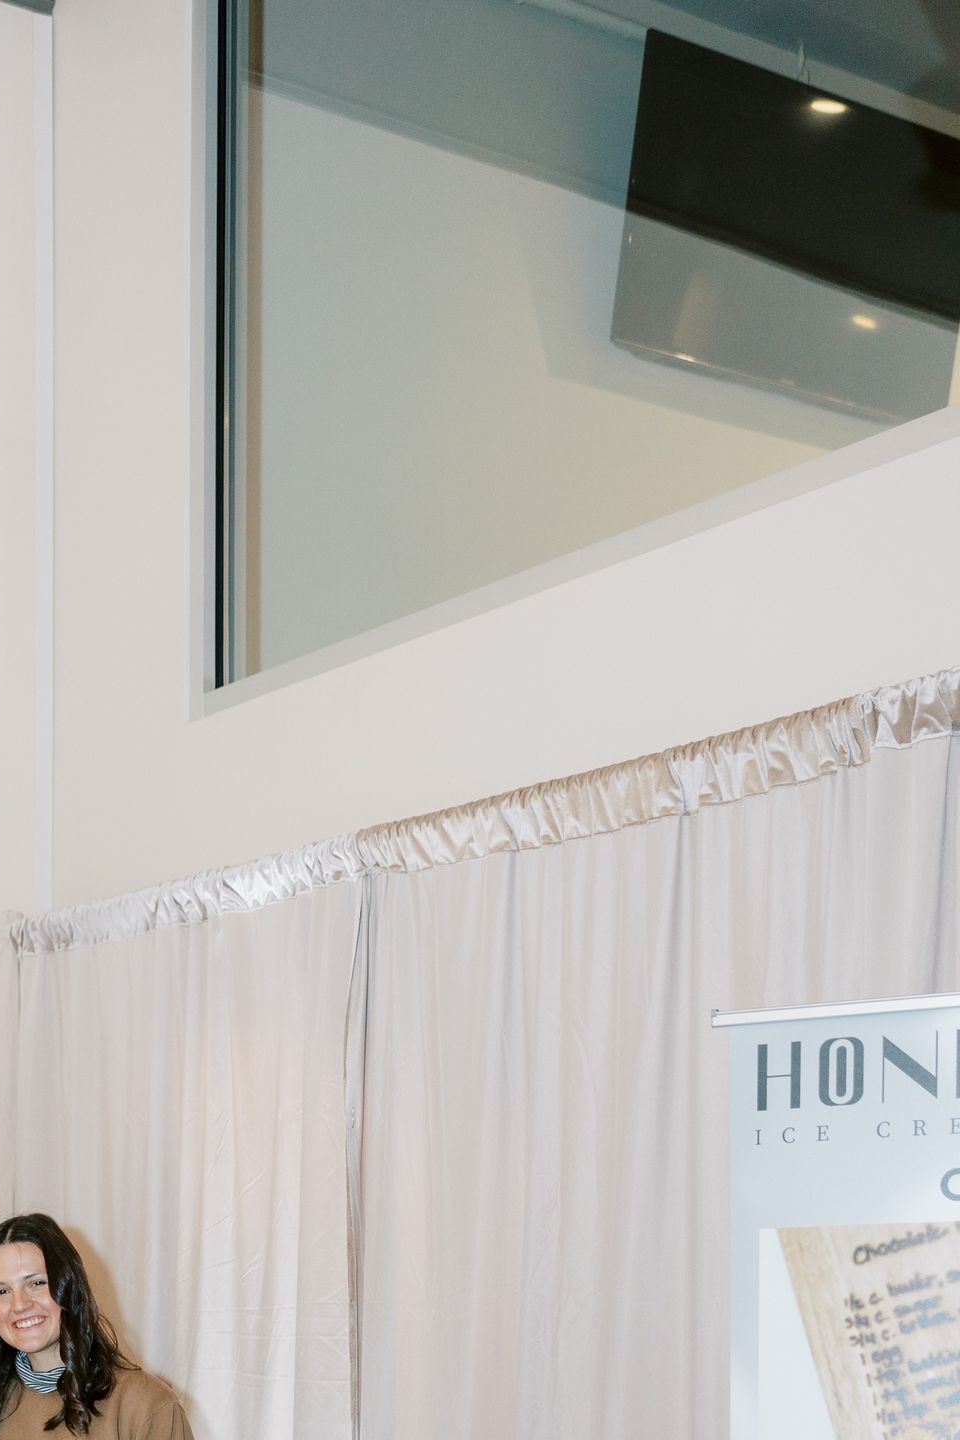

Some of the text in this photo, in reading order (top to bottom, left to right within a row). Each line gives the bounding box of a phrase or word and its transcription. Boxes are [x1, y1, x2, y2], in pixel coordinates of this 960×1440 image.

[757, 1029, 960, 1111] HON
[755, 1117, 960, 1146] ICE CRE
